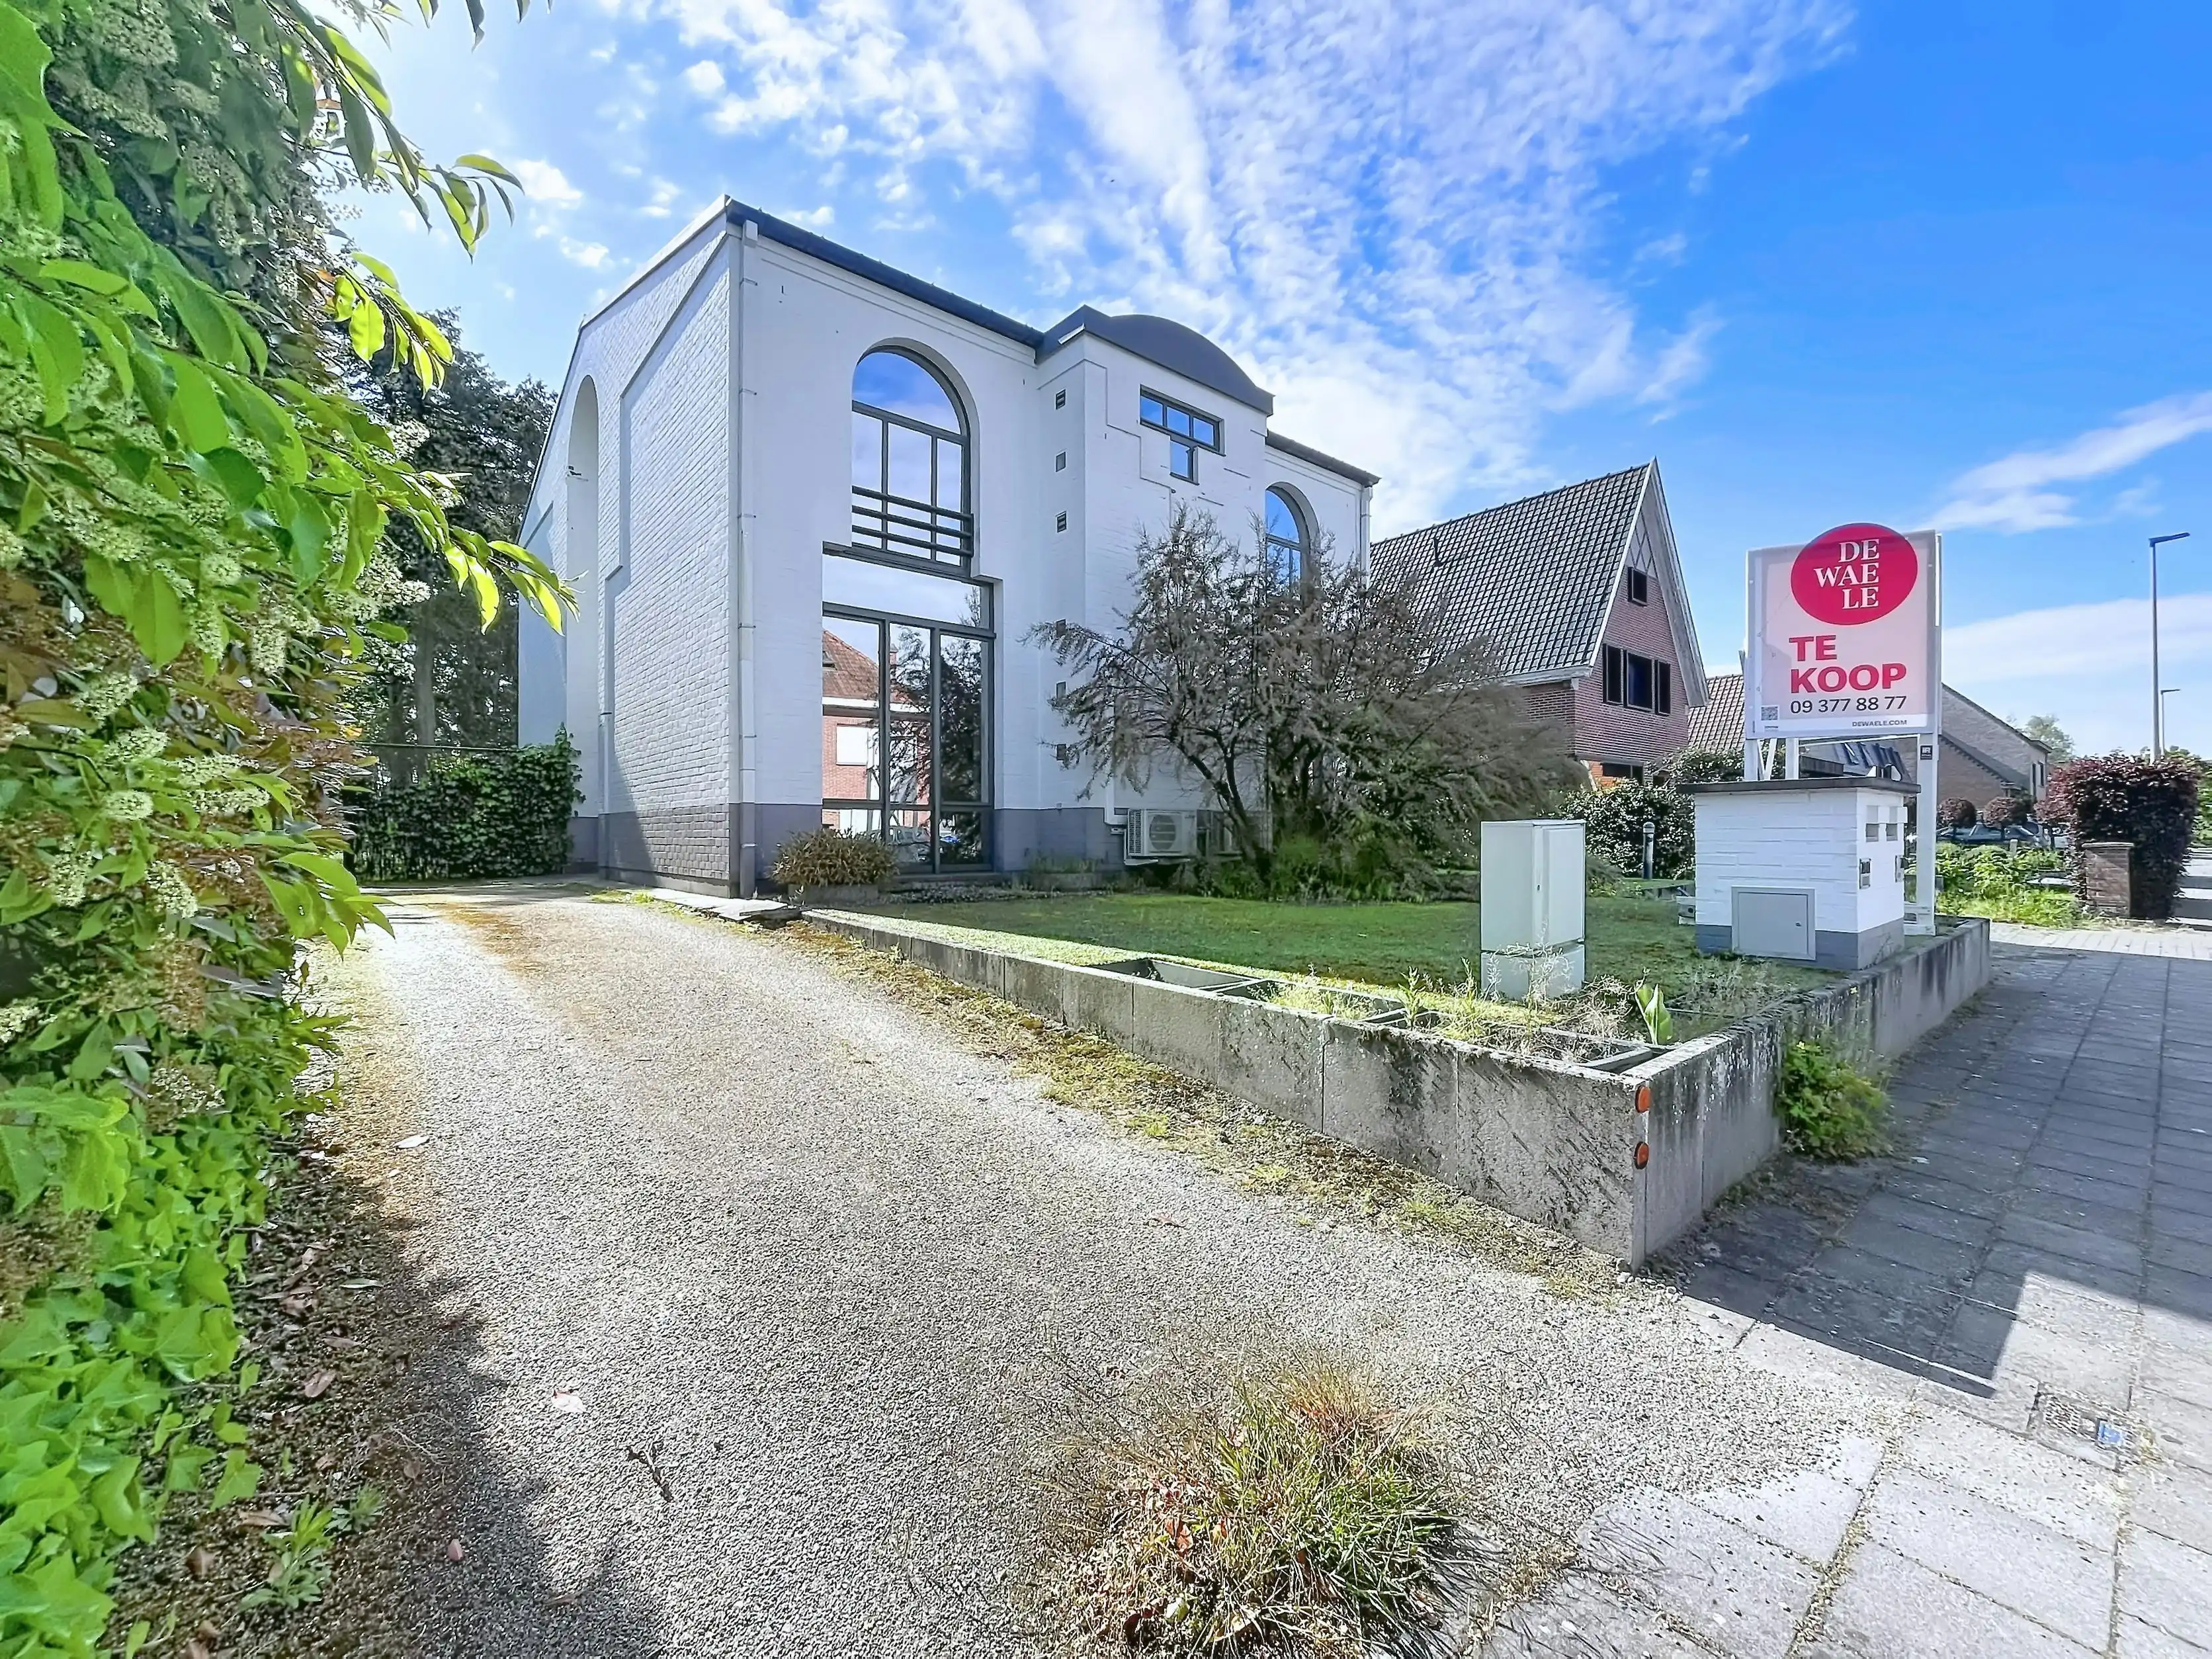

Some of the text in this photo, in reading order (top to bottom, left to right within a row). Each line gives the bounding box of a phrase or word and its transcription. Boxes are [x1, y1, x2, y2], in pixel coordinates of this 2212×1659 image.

[1838, 538, 1879, 562] DE
[1813, 562, 1879, 587] WAE
[1842, 586, 1879, 609] LE
[1789, 635, 1838, 661] TE
[1791, 663, 1907, 694] KOOP
[1790, 695, 1907, 714] 09 377 88 77
